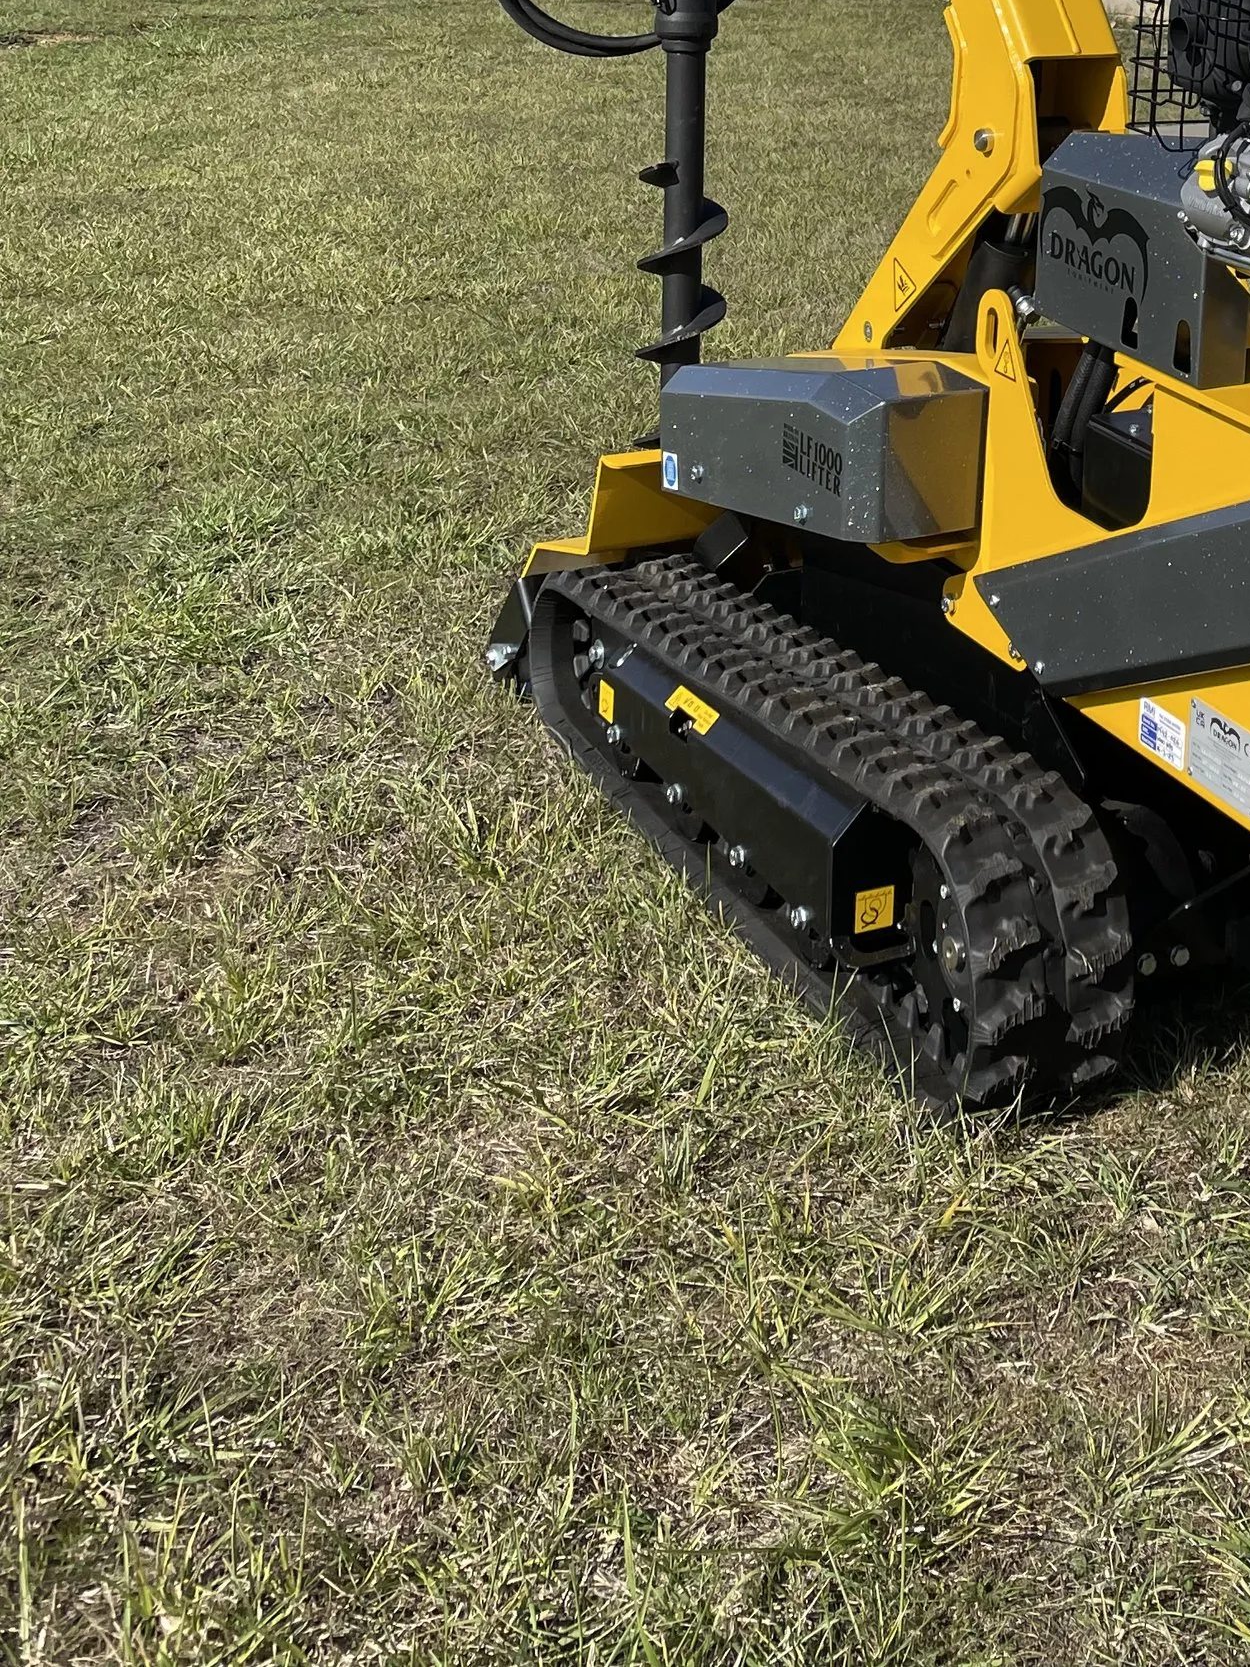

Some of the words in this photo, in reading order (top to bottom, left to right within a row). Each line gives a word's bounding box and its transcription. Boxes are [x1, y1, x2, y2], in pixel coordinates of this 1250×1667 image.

[1051, 231, 1135, 294] DRAGON
[799, 454, 841, 498] LIFTER
[800, 431, 843, 476] LF1000
